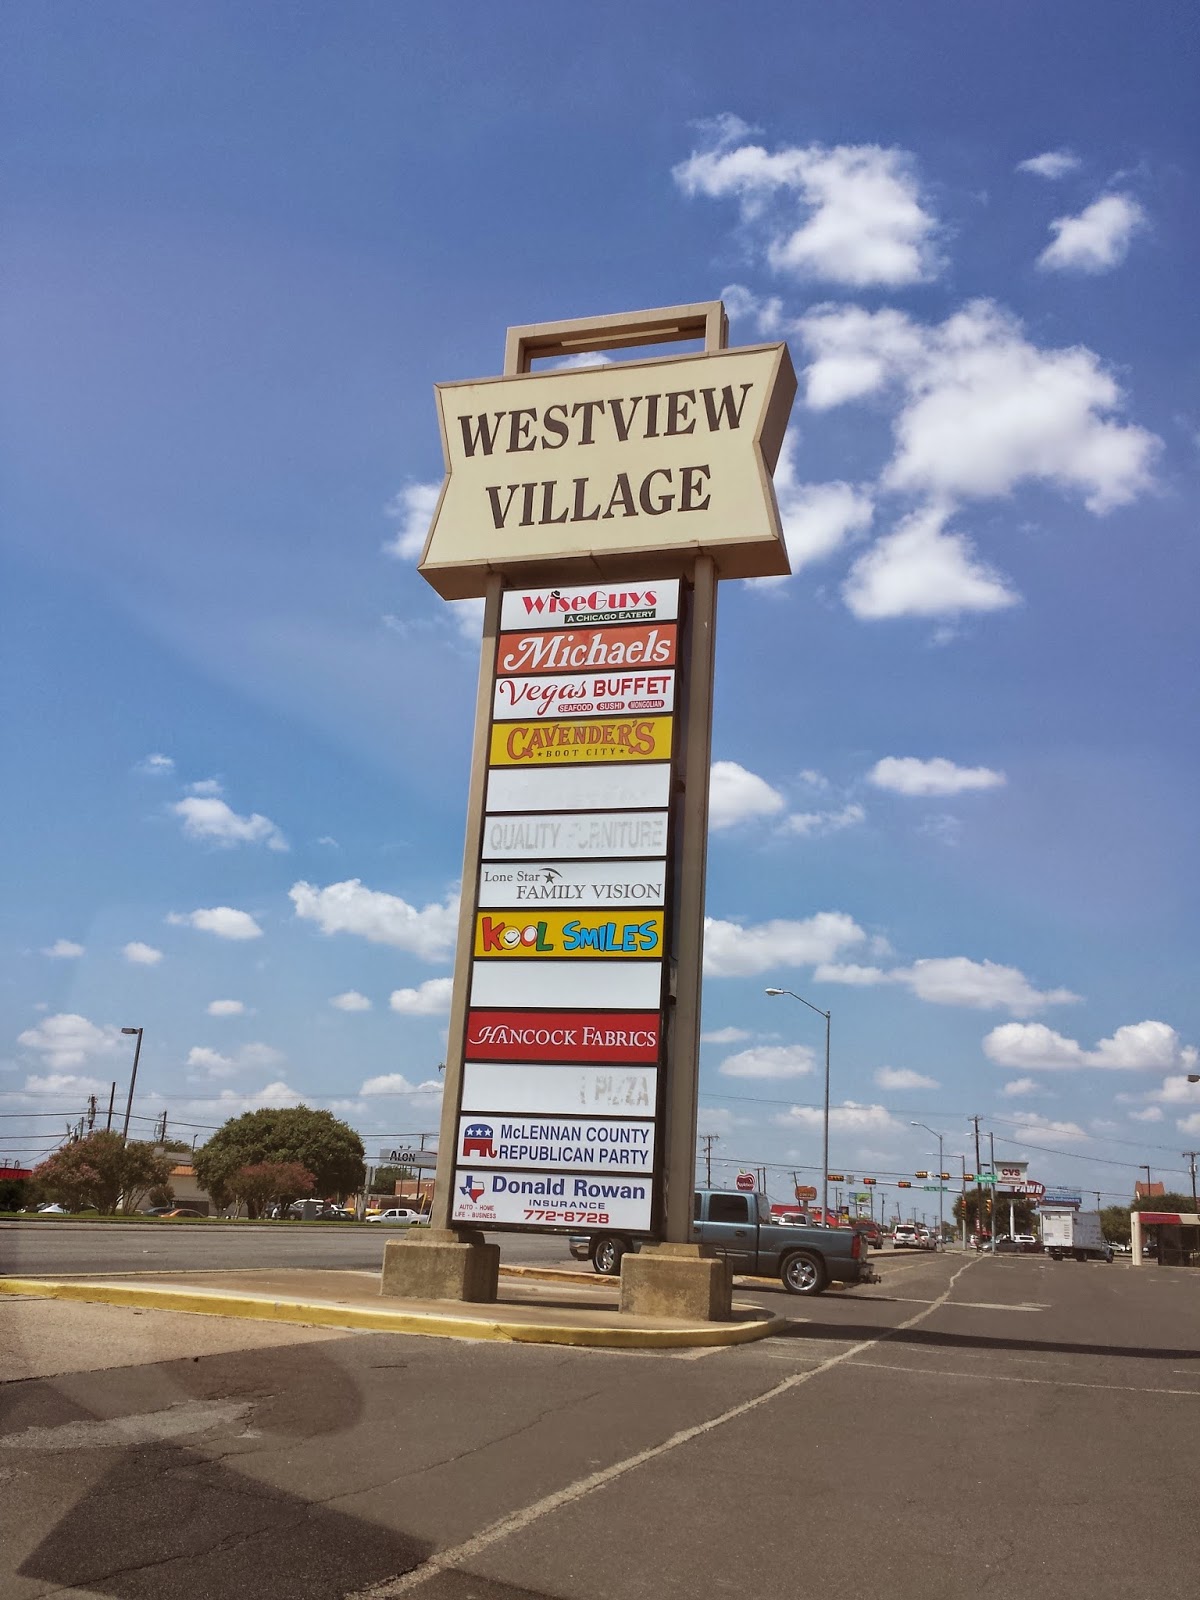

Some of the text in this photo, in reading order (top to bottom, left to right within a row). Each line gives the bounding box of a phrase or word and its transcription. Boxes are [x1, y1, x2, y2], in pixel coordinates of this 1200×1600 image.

[457, 382, 754, 458] WESTVIEW
[485, 463, 712, 530] VILLAGE
[522, 590, 657, 615] WiseGuys
[567, 610, 654, 623] A CHICAGO EATERY
[503, 629, 671, 671] Michaels
[499, 676, 671, 716] Vegas BUFFET
[559, 700, 662, 712] SEAFOOD SUSHI MONGOLIAN
[507, 719, 656, 760] CAVENDER'S
[546, 748, 615, 758] BOOT CITY
[489, 819, 664, 851] QUALITY RNITURE
[484, 871, 541, 882] Lone Star
[516, 883, 662, 900] FAMILY VISION
[481, 916, 659, 952] KOOL SMILES
[468, 1024, 657, 1047] HANCOCK FABRICS
[500, 1124, 650, 1144] McLENNAN COUNTY
[499, 1145, 649, 1165] REPUBLICAN PARTY
[1001, 1168, 1021, 1177] CVS
[492, 1175, 646, 1200] Donald Rowan
[1014, 1184, 1043, 1194] PAWN
[528, 1199, 606, 1210] INSURANCE
[523, 1209, 610, 1224] 772-8728
